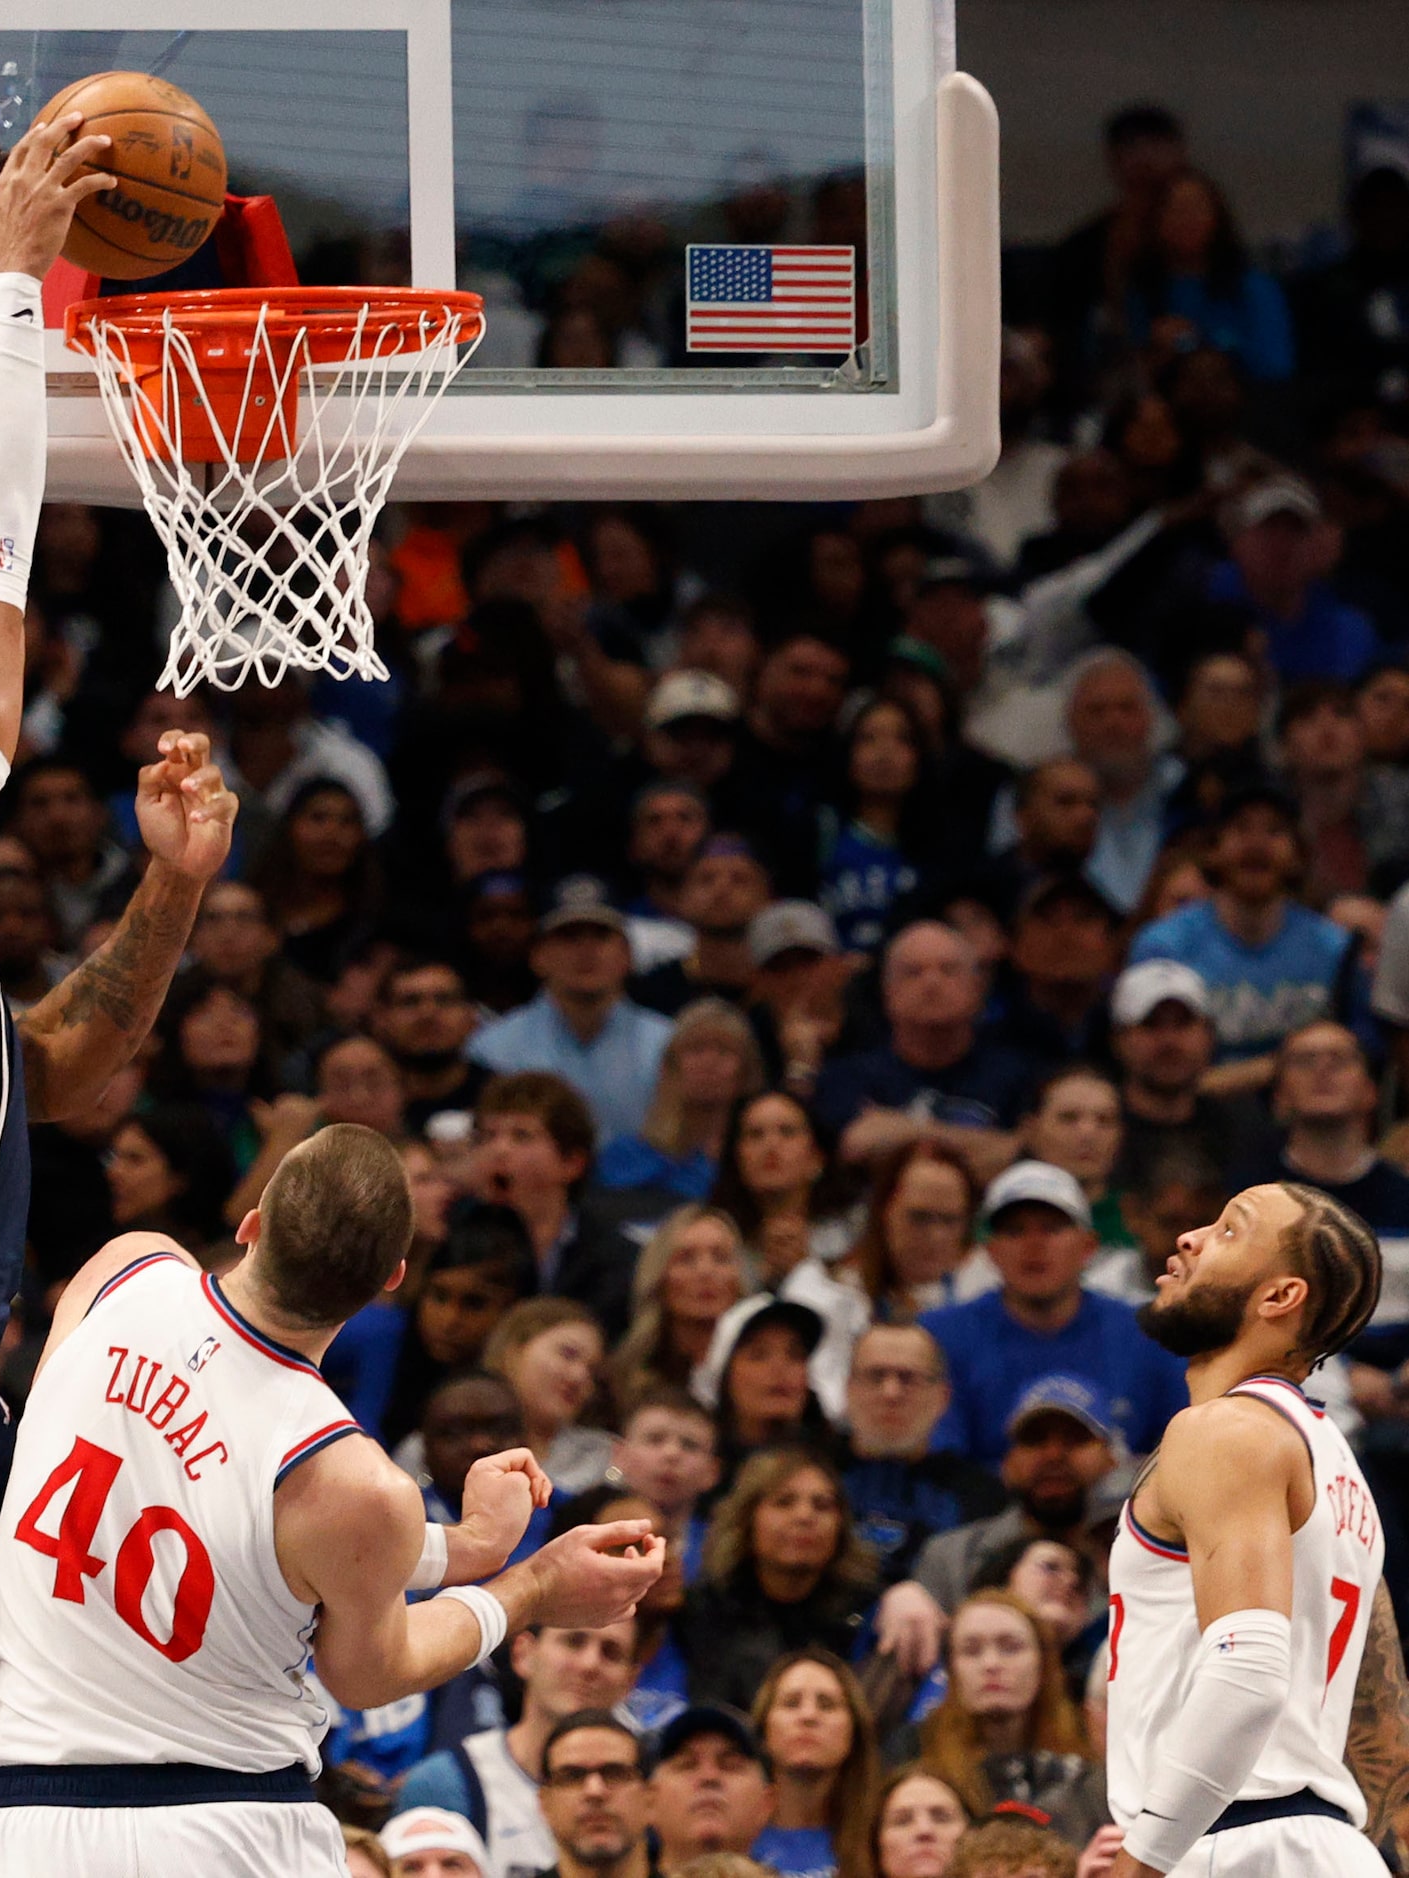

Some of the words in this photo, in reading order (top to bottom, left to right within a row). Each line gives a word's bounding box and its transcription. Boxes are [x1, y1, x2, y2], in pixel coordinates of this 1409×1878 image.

[95, 188, 210, 250] Wilson
[105, 1346, 228, 1481] ZUBAC
[13, 1435, 215, 1663] 40
[1320, 1575, 1361, 1710] 7
